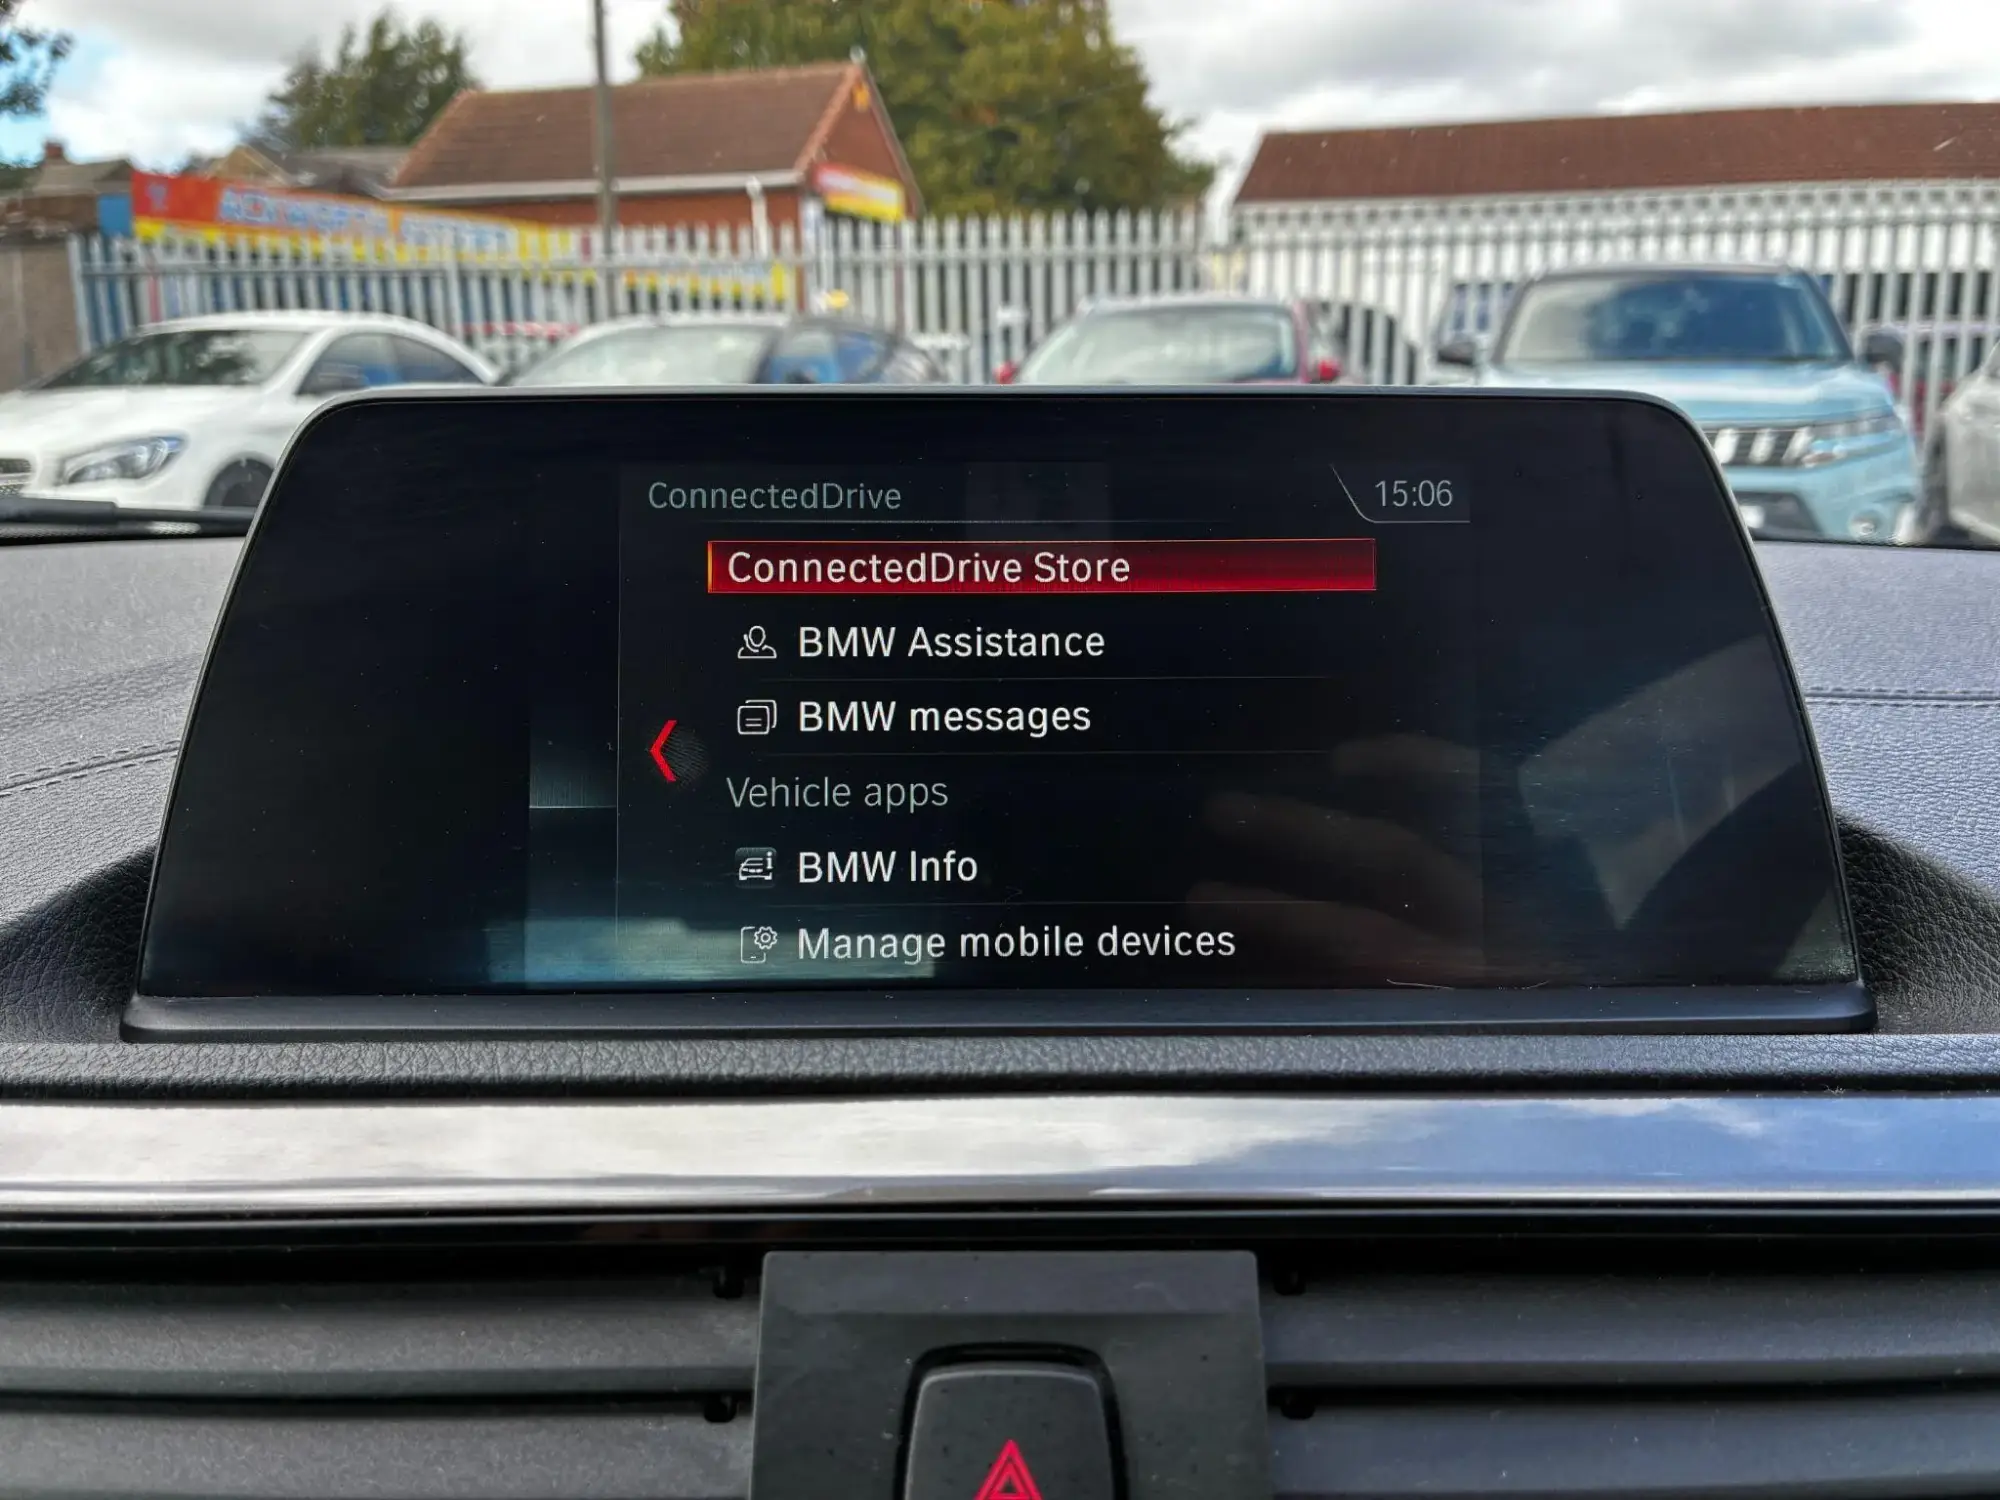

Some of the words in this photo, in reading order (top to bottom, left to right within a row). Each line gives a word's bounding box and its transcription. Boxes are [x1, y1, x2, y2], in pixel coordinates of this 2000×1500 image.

[648, 482, 901, 510] ConnectedDrive
[1375, 480, 1453, 507] 15:06
[728, 551, 1022, 583] ConnectedDrive
[1034, 551, 1130, 583] Store
[798, 626, 896, 658] BMW
[907, 627, 1105, 658] Assistance
[798, 700, 896, 732] BMW
[910, 704, 1091, 739] messages
[726, 776, 851, 808] Vehicle
[864, 781, 950, 814] apps
[798, 850, 897, 883] BMW
[910, 850, 978, 883] Info
[798, 927, 945, 965] Manage
[960, 925, 1084, 957] mobile
[1097, 925, 1236, 957] devices
